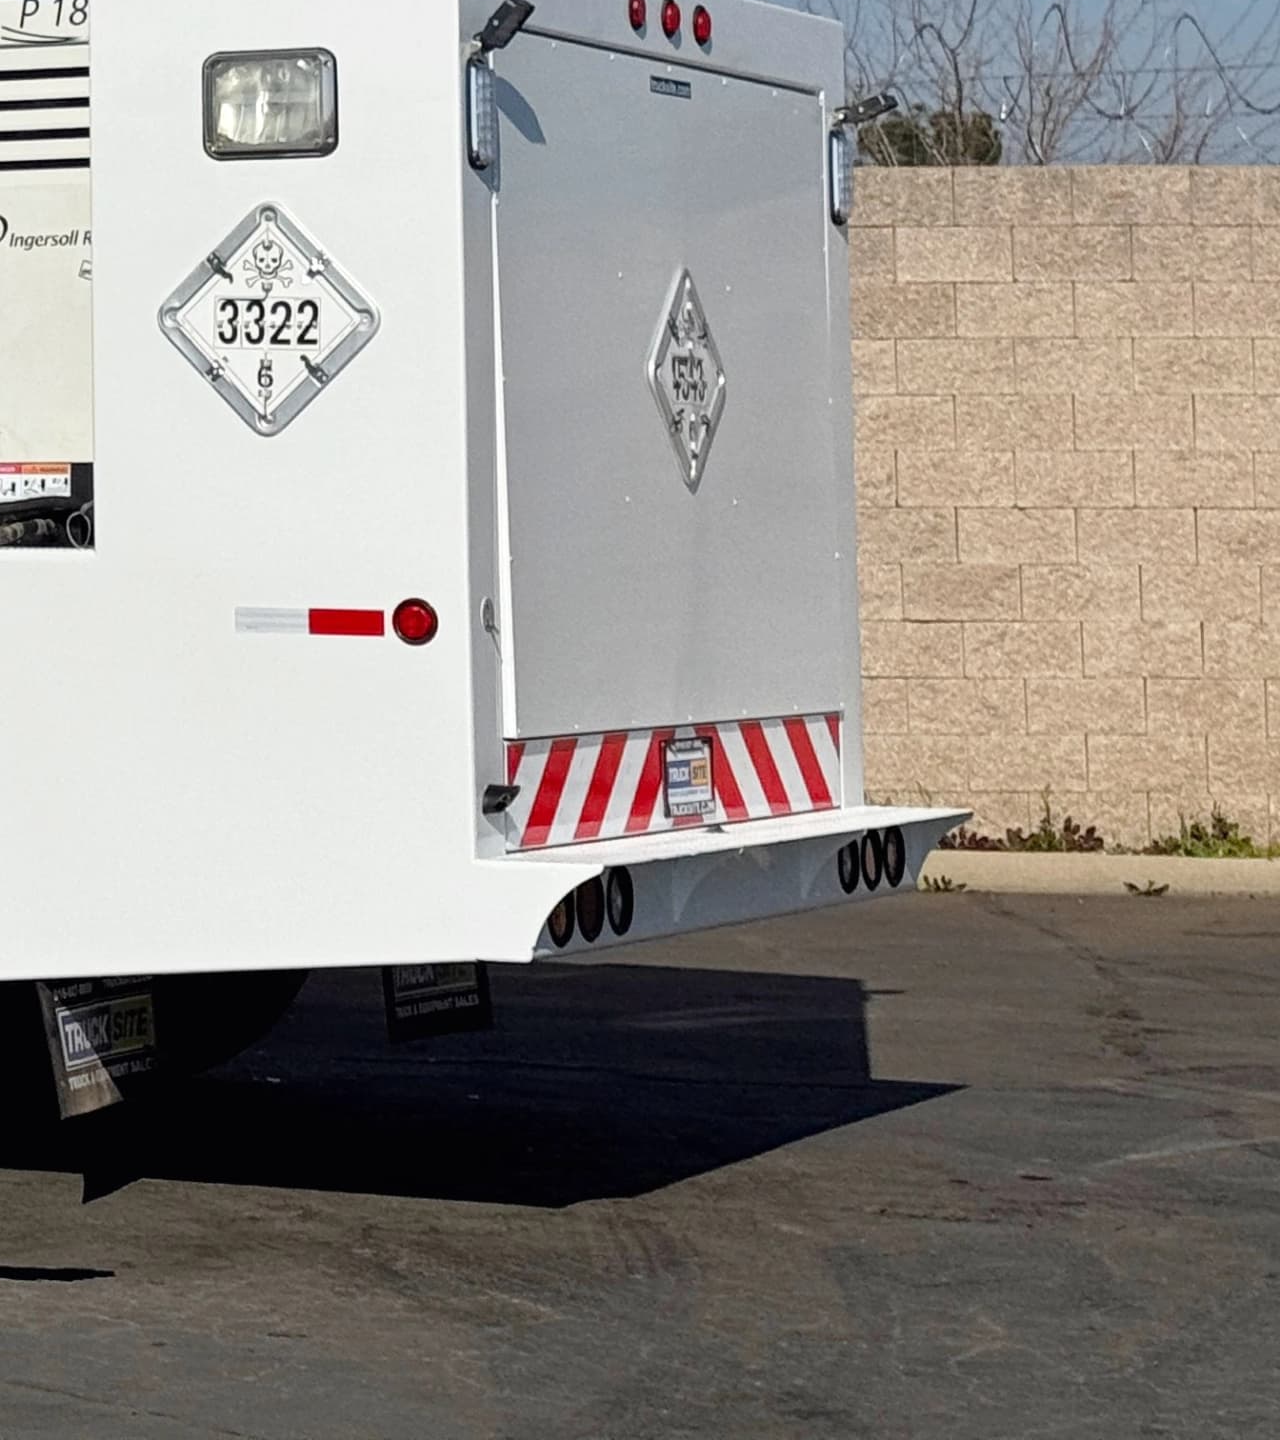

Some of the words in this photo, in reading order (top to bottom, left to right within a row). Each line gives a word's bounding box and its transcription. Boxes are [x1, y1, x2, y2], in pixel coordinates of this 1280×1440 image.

[9, 229, 80, 252] Ingersoll
[218, 299, 319, 346] 3322
[257, 363, 274, 388] 6
[64, 1013, 109, 1054] TRUCK
[111, 1005, 148, 1042] SITE
